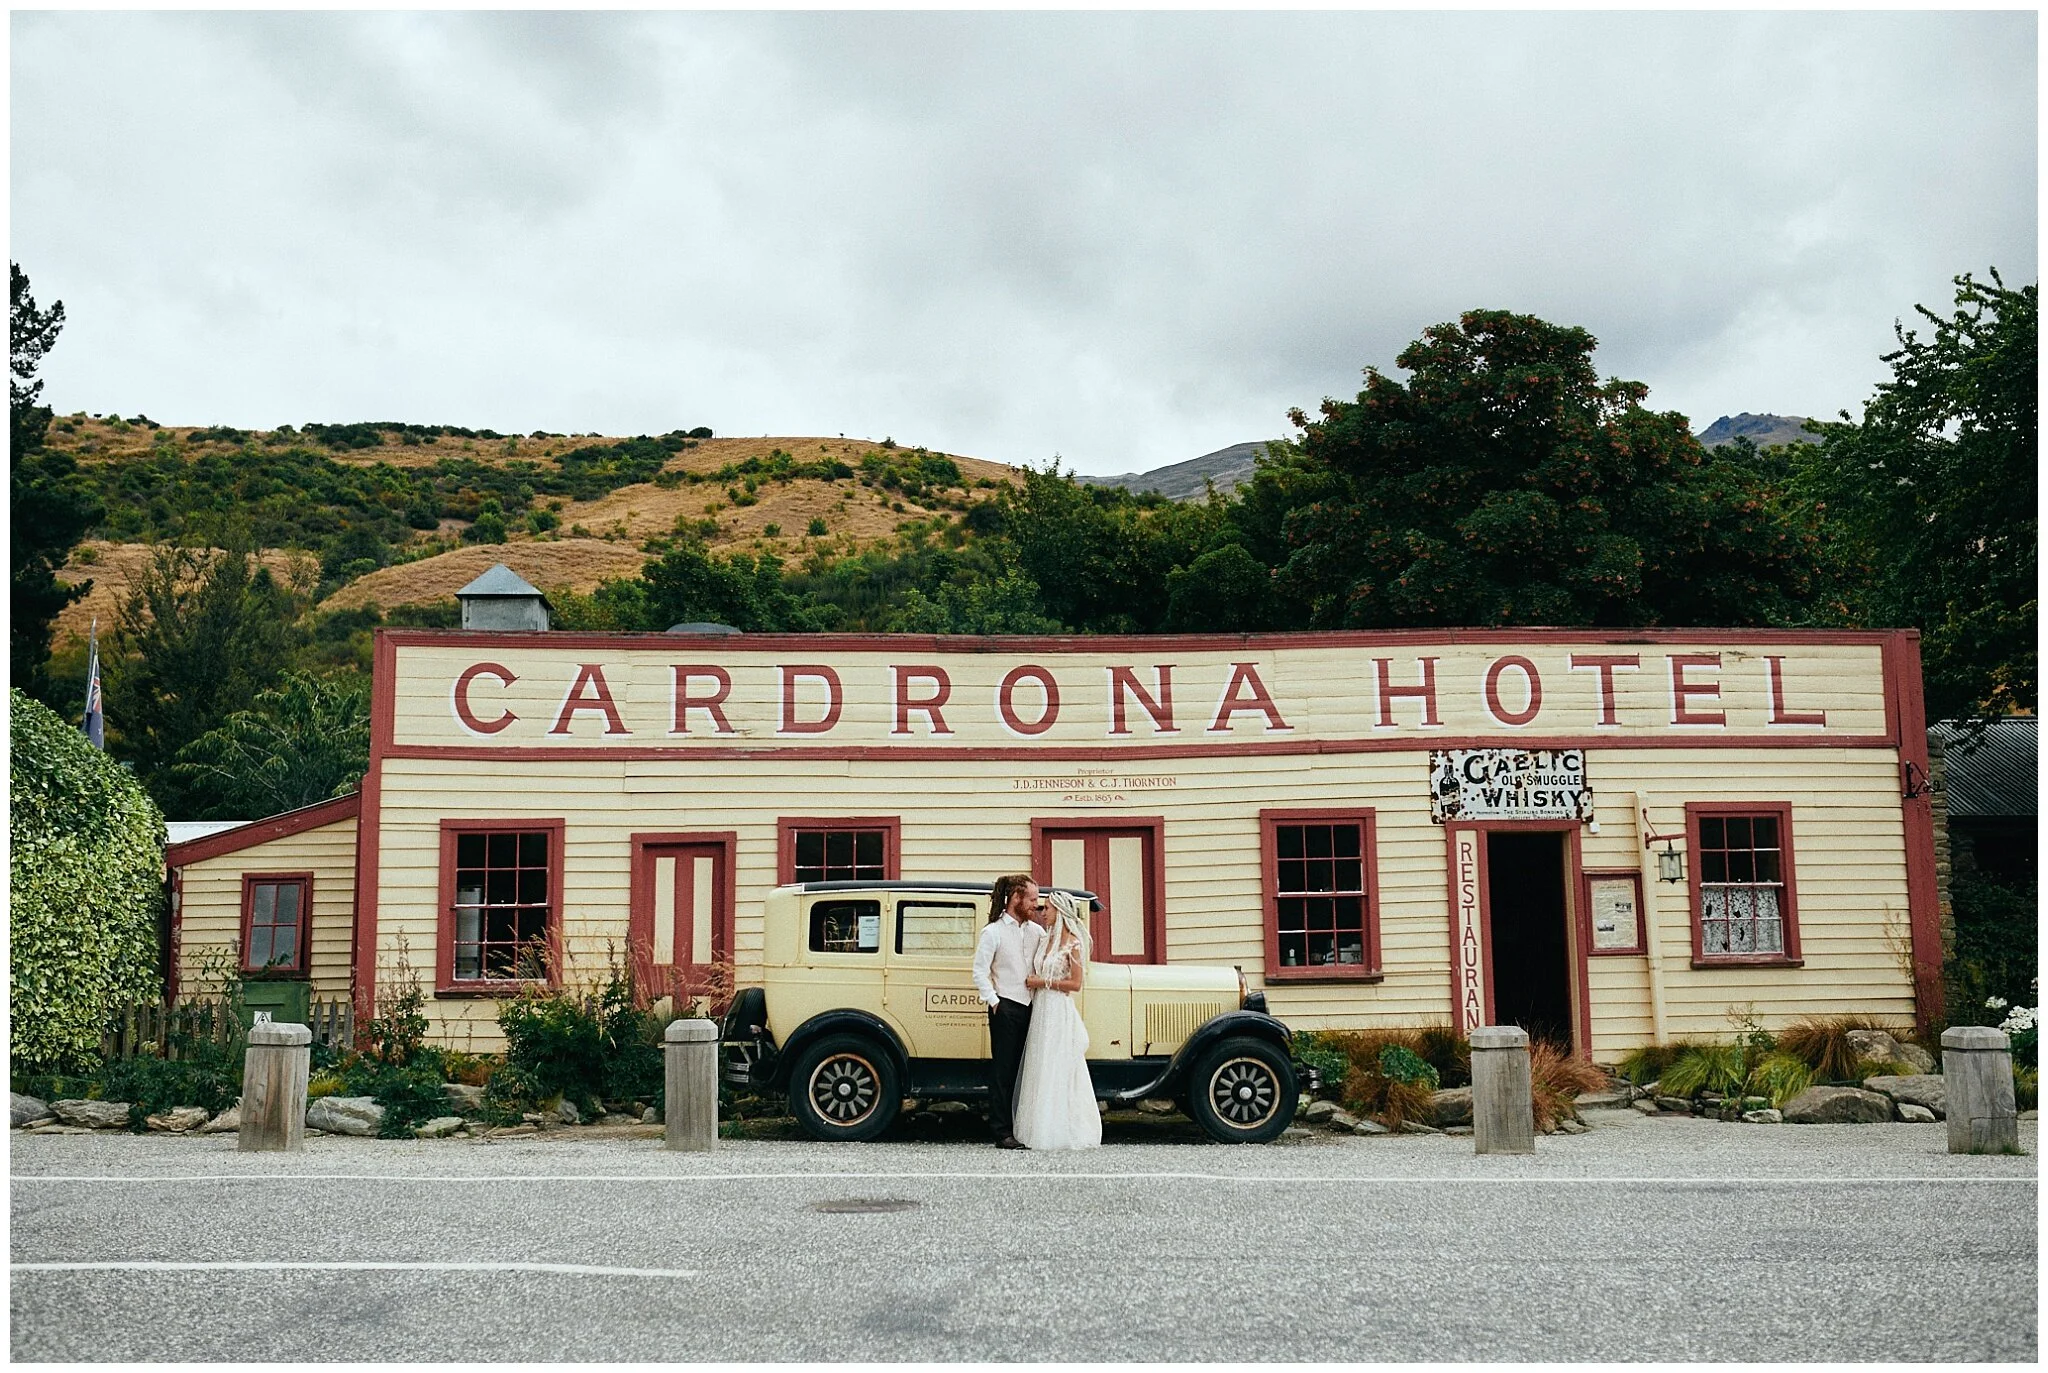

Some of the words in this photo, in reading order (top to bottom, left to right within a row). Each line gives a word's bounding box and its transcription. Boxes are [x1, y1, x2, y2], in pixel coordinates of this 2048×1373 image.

[451, 661, 1295, 738] CARDRONA
[1373, 653, 1826, 731] HOTEL
[1088, 778, 1096, 788] &
[1123, 776, 1177, 788] THORNTON
[1463, 754, 1581, 785] GAELIC
[1526, 774, 1585, 786] SMUGGLE
[1481, 787, 1583, 808] WHISKY
[1460, 842, 1481, 1035] RESTAURAN
